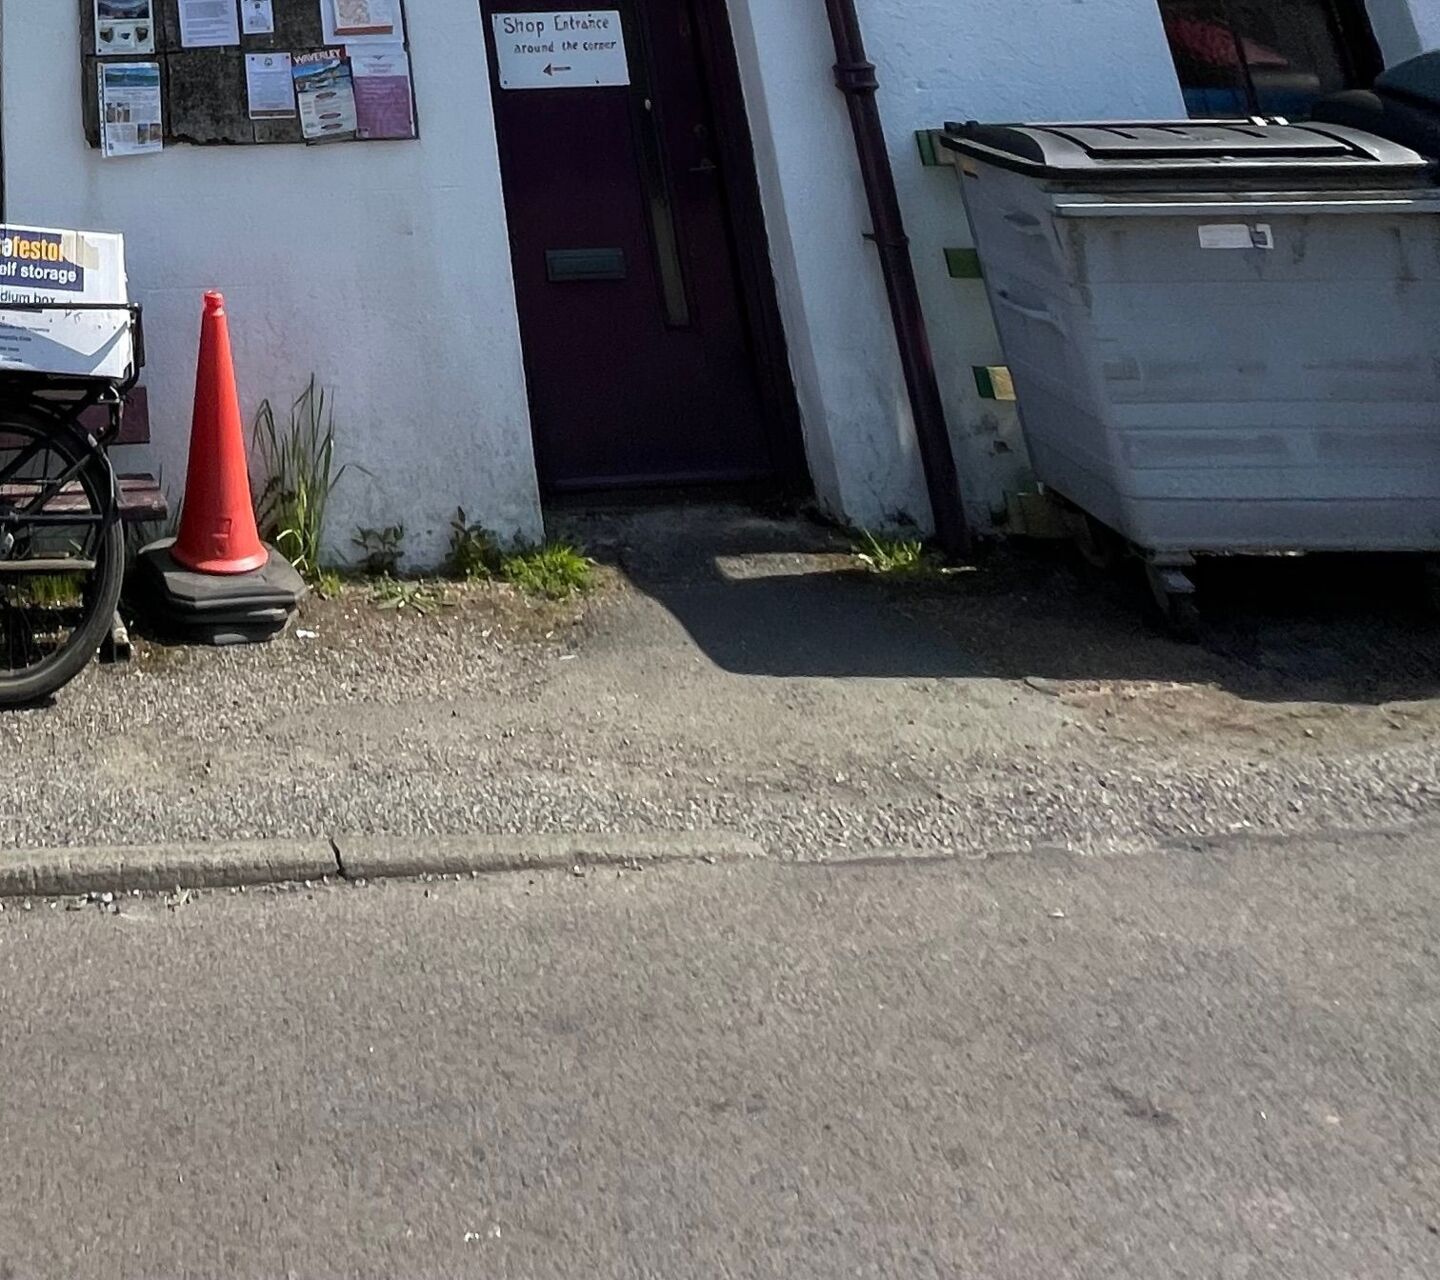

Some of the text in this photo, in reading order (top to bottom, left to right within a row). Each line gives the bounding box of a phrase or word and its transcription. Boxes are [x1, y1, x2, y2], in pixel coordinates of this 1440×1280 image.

[503, 14, 609, 38] Shop Entrance
[514, 40, 617, 54] around the corner
[293, 49, 341, 65] WAVERLEY
[20, 264, 77, 285] storage
[34, 292, 56, 304] box
